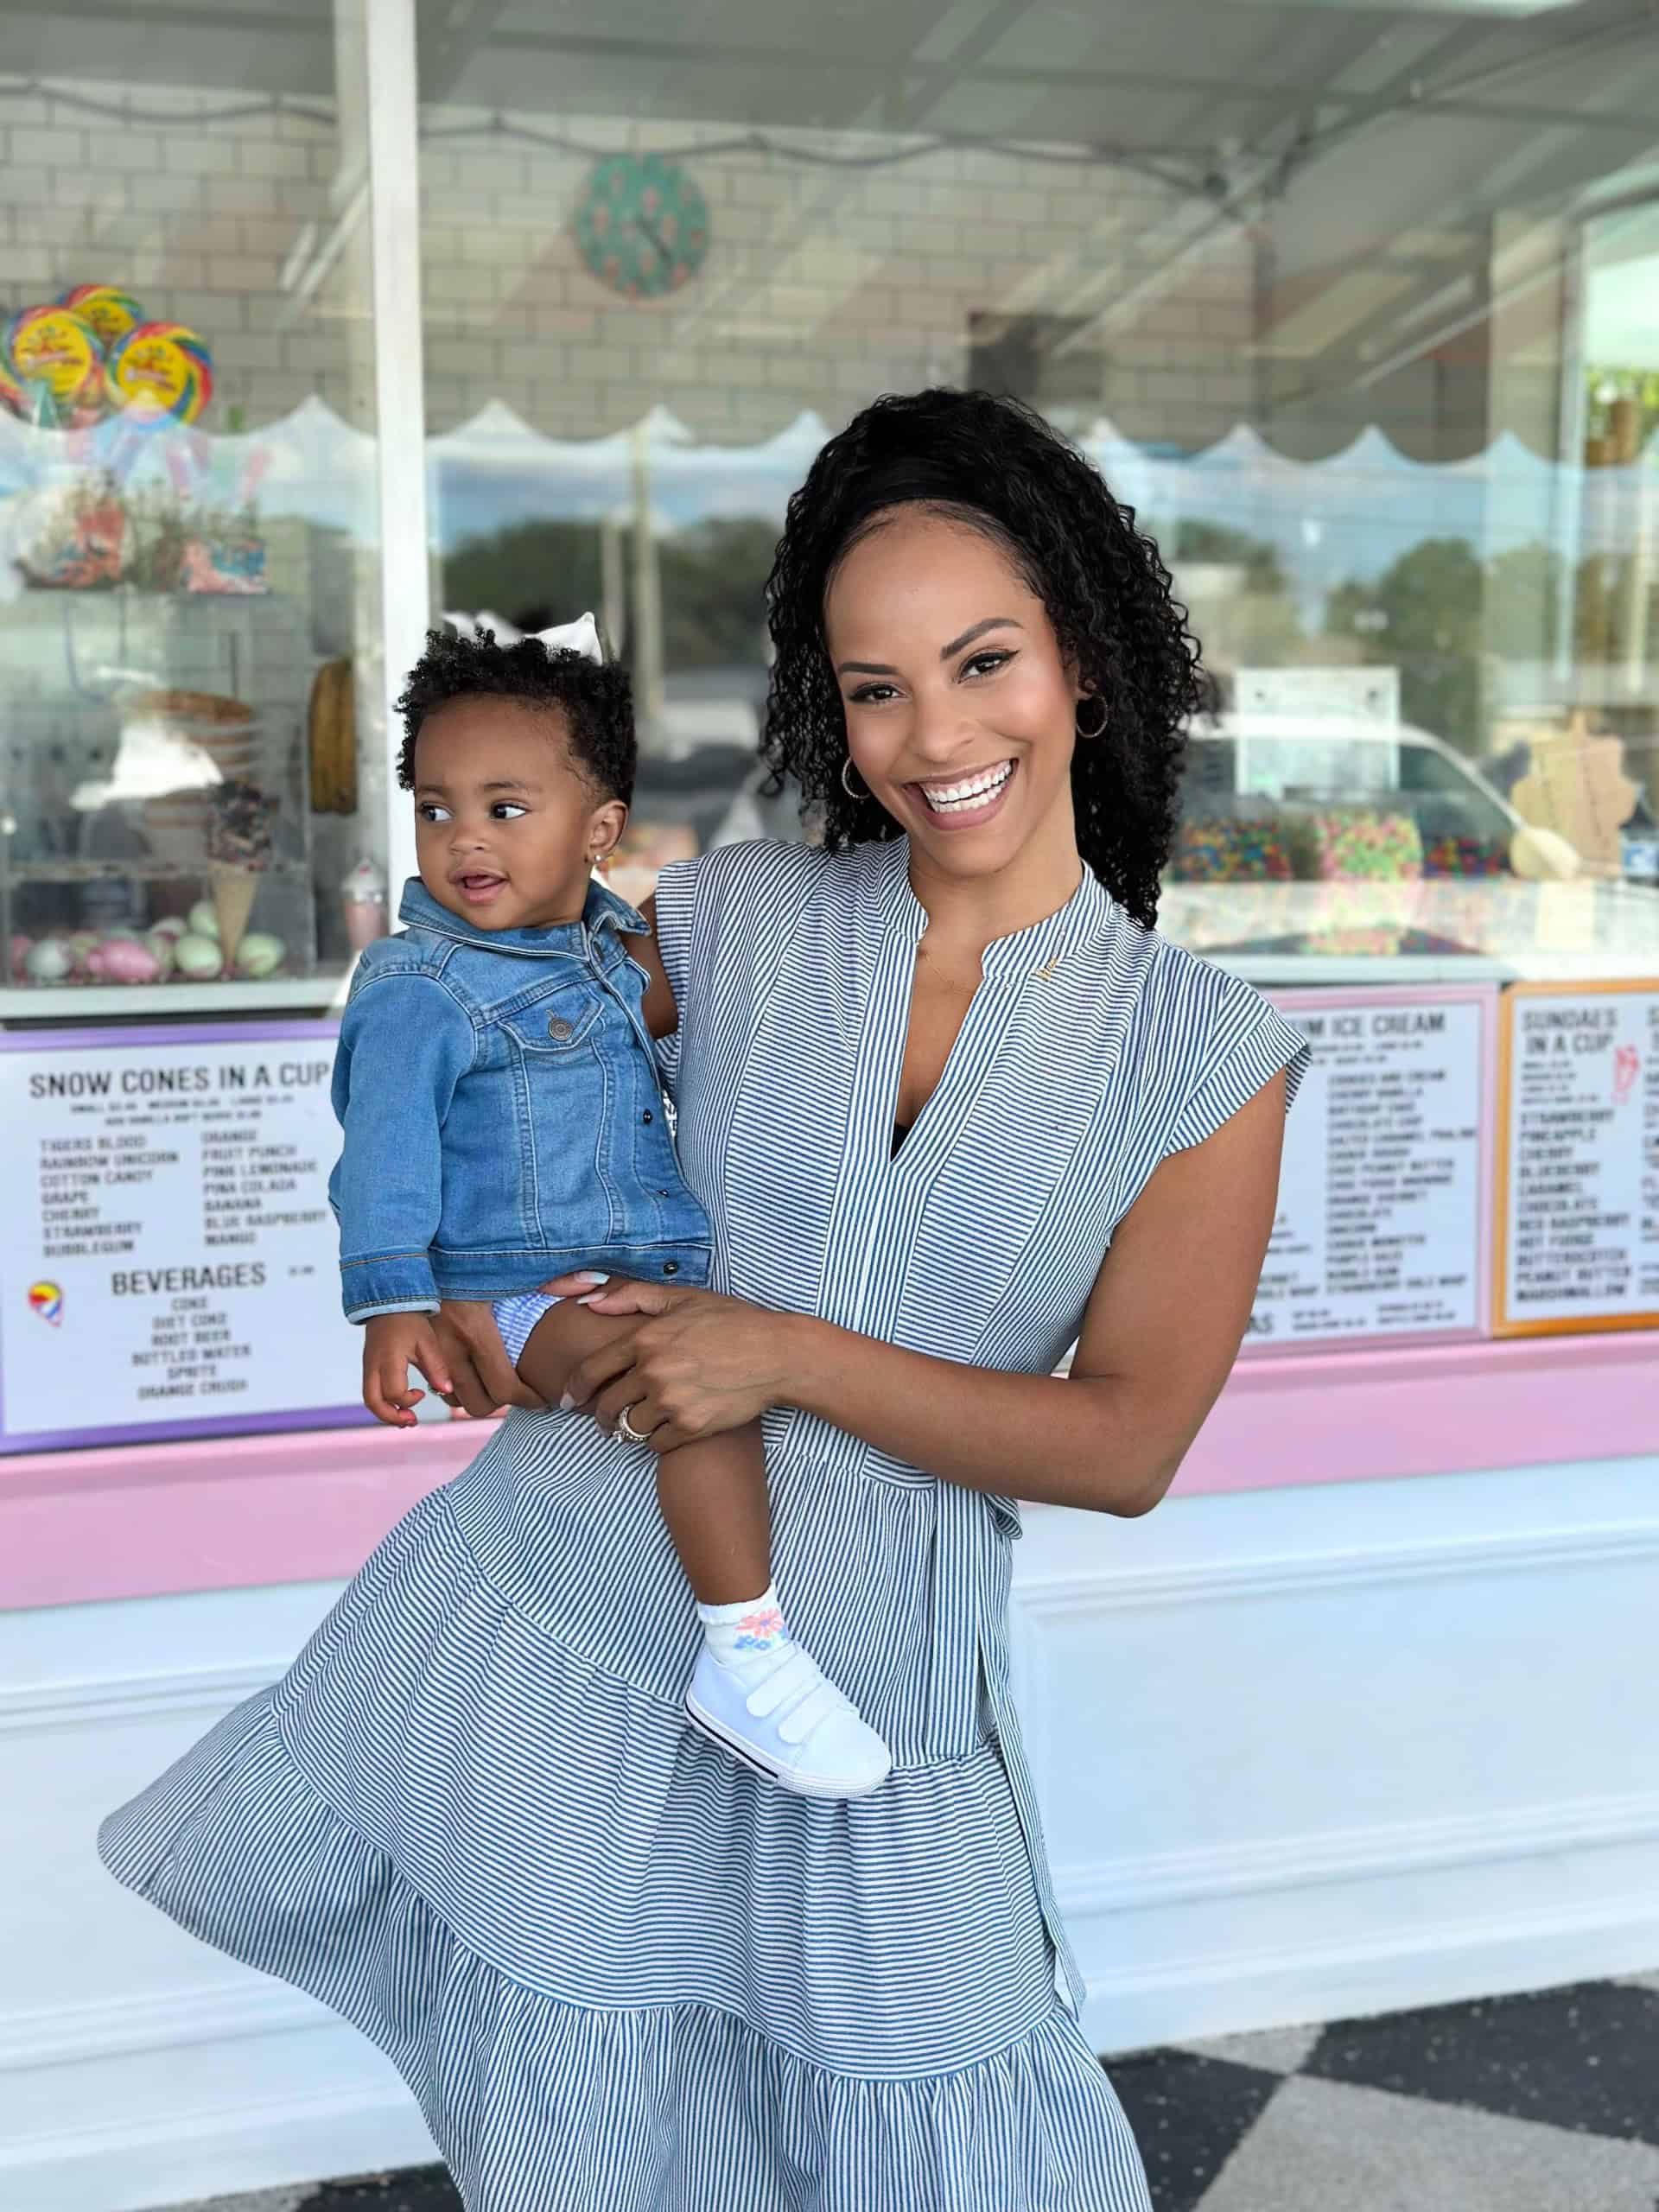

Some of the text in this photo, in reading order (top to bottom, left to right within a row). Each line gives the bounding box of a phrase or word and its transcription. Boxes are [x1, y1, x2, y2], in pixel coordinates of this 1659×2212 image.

[1332, 1016, 1363, 1036] ICE
[1372, 1013, 1445, 1034] CREAM
[1523, 1007, 1618, 1032] SUNDAES
[1526, 1033, 1613, 1053] IN A CUP
[29, 1062, 329, 1098] SNOW CONES IN A CUP
[111, 1262, 266, 1296] BEVERAGES
[171, 1296, 208, 1312] COKE
[192, 1312, 227, 1327] COKE
[195, 1329, 232, 1344] BEER
[132, 1343, 252, 1366] BOTTLED WATER
